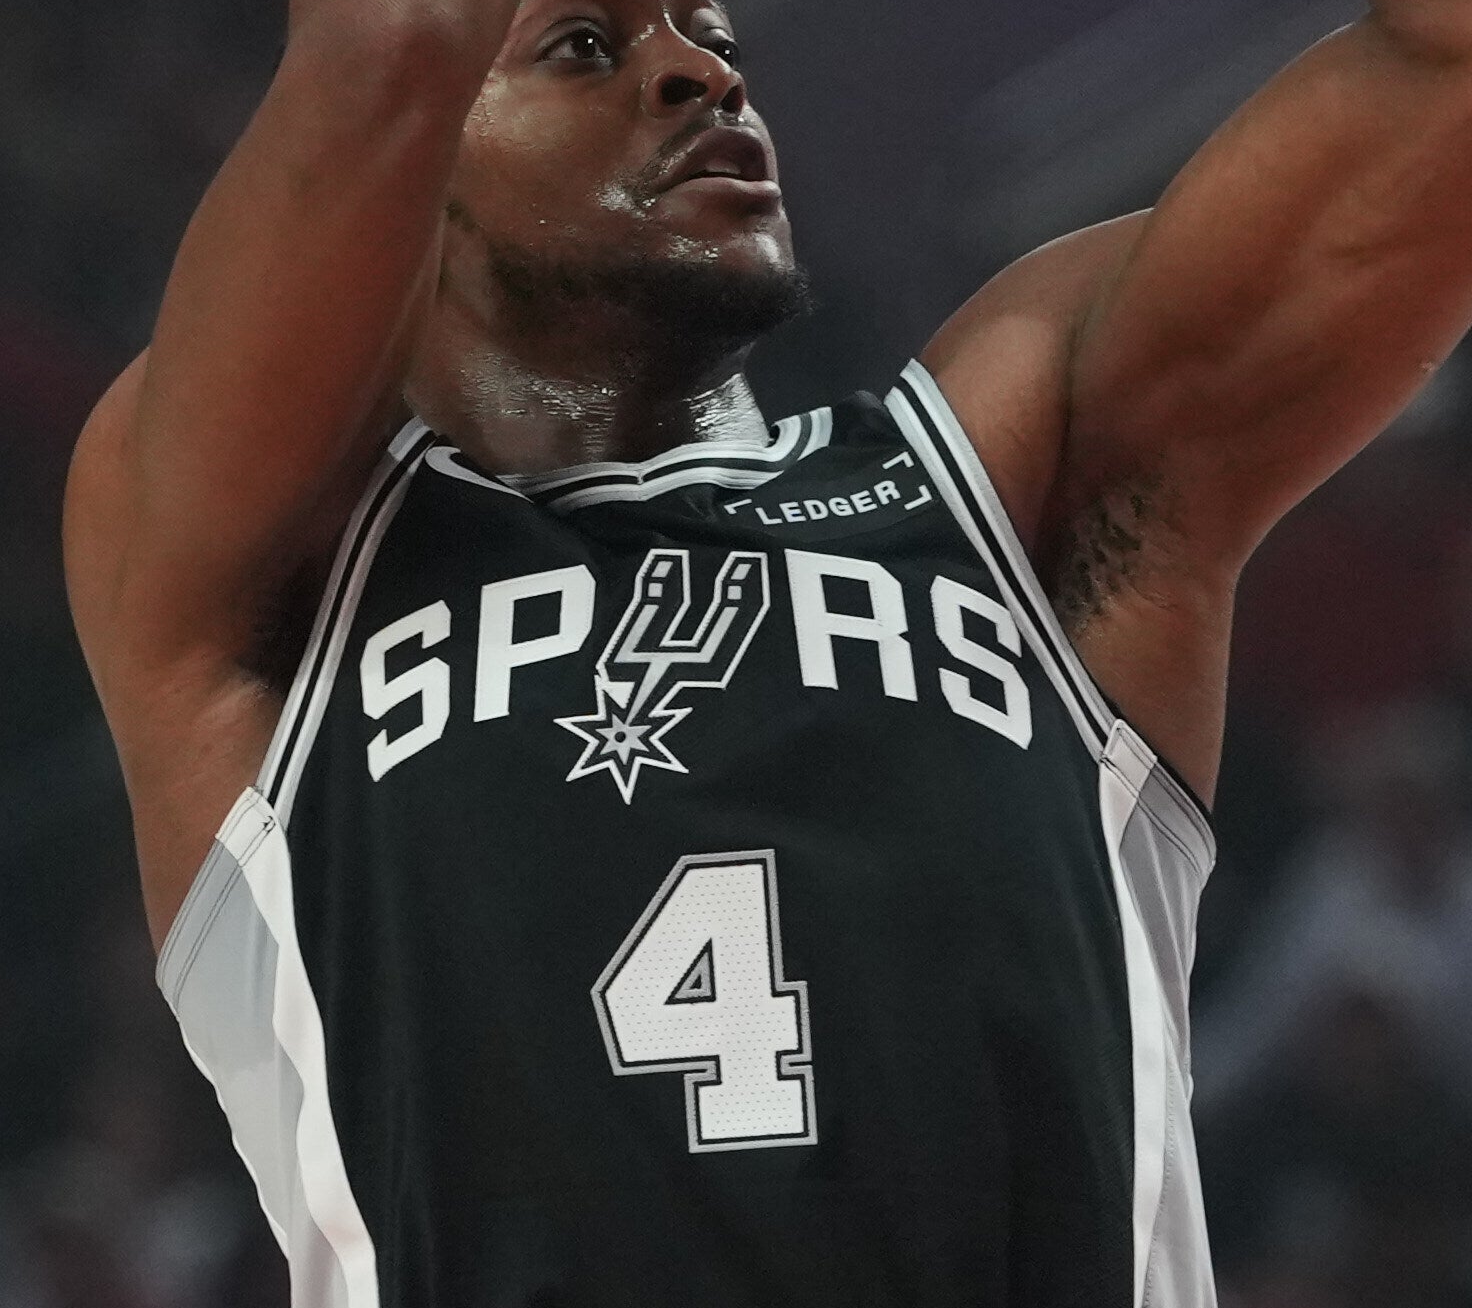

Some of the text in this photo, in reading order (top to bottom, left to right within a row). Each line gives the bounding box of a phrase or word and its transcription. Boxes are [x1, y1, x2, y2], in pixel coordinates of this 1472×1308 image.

[755, 480, 902, 525] LEDGER
[359, 548, 1033, 803] SPURS
[591, 849, 817, 1153] 4
